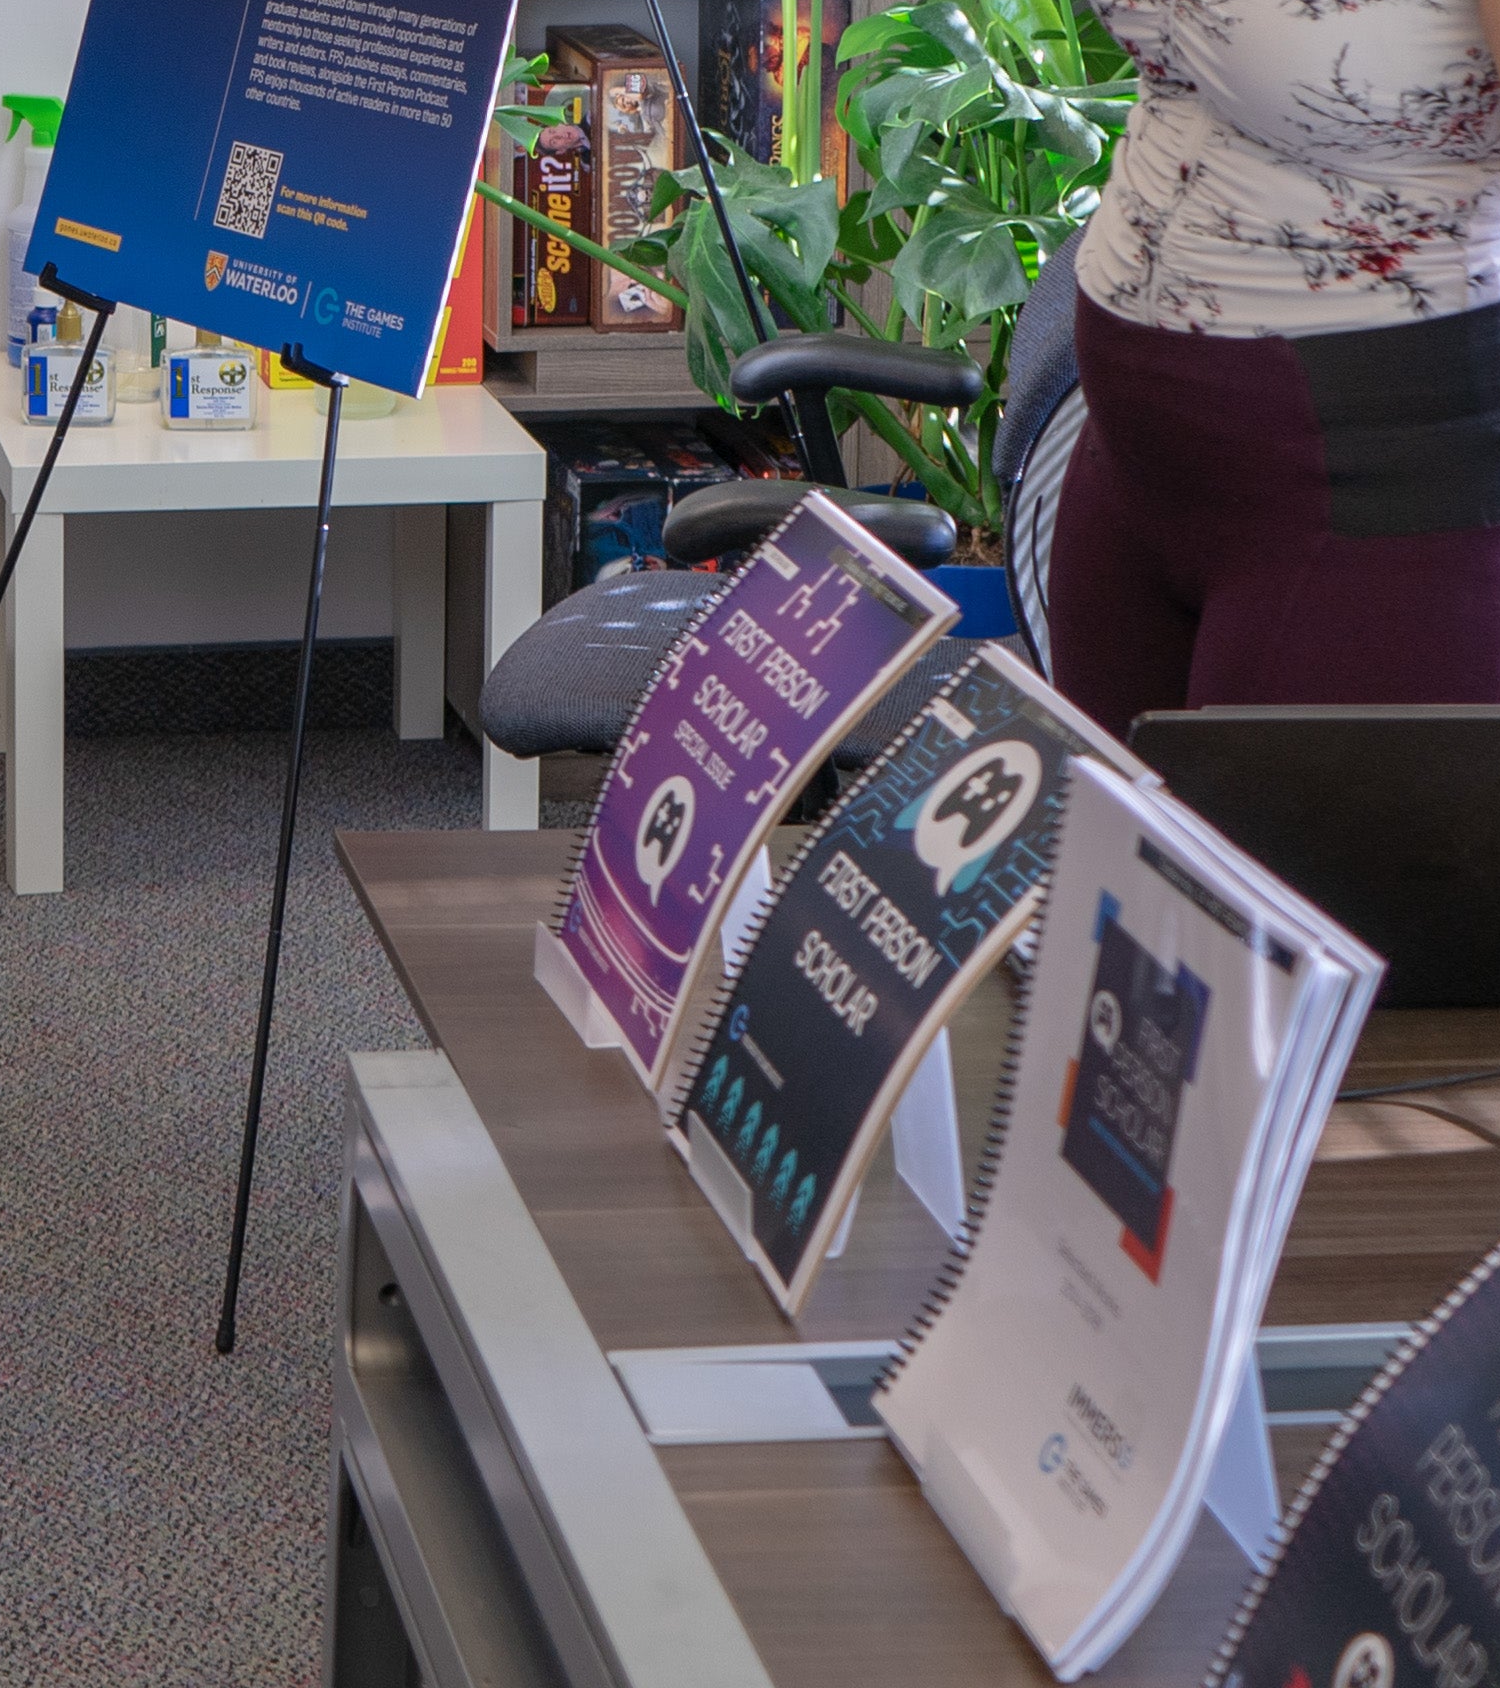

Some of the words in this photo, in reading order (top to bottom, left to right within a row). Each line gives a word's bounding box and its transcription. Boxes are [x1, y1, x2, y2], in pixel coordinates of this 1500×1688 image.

[539, 156, 572, 193] it?
[276, 203, 297, 217] scan
[296, 207, 314, 221] this
[313, 211, 327, 226] QR
[325, 217, 348, 231] code.
[280, 185, 296, 198] For
[295, 191, 318, 206] more
[318, 195, 367, 219] information
[546, 193, 572, 274] scne
[226, 268, 298, 305] WATERLOO
[232, 259, 283, 280] UNIVERSITY
[285, 274, 298, 285] OF
[341, 317, 382, 339] INSTITUTE
[345, 301, 366, 319] THE
[367, 308, 404, 331] GAMES
[190, 374, 201, 384] st
[190, 383, 239, 397] Response
[717, 608, 776, 664] FIRST
[755, 645, 831, 721] PERSON
[693, 674, 770, 760] SCHOLAR
[673, 718, 712, 766] SPECIAL
[702, 751, 737, 792] ISSUE
[817, 849, 881, 919] FIRST
[860, 896, 944, 989] PERSON
[795, 929, 880, 1038] SCHOLAR
